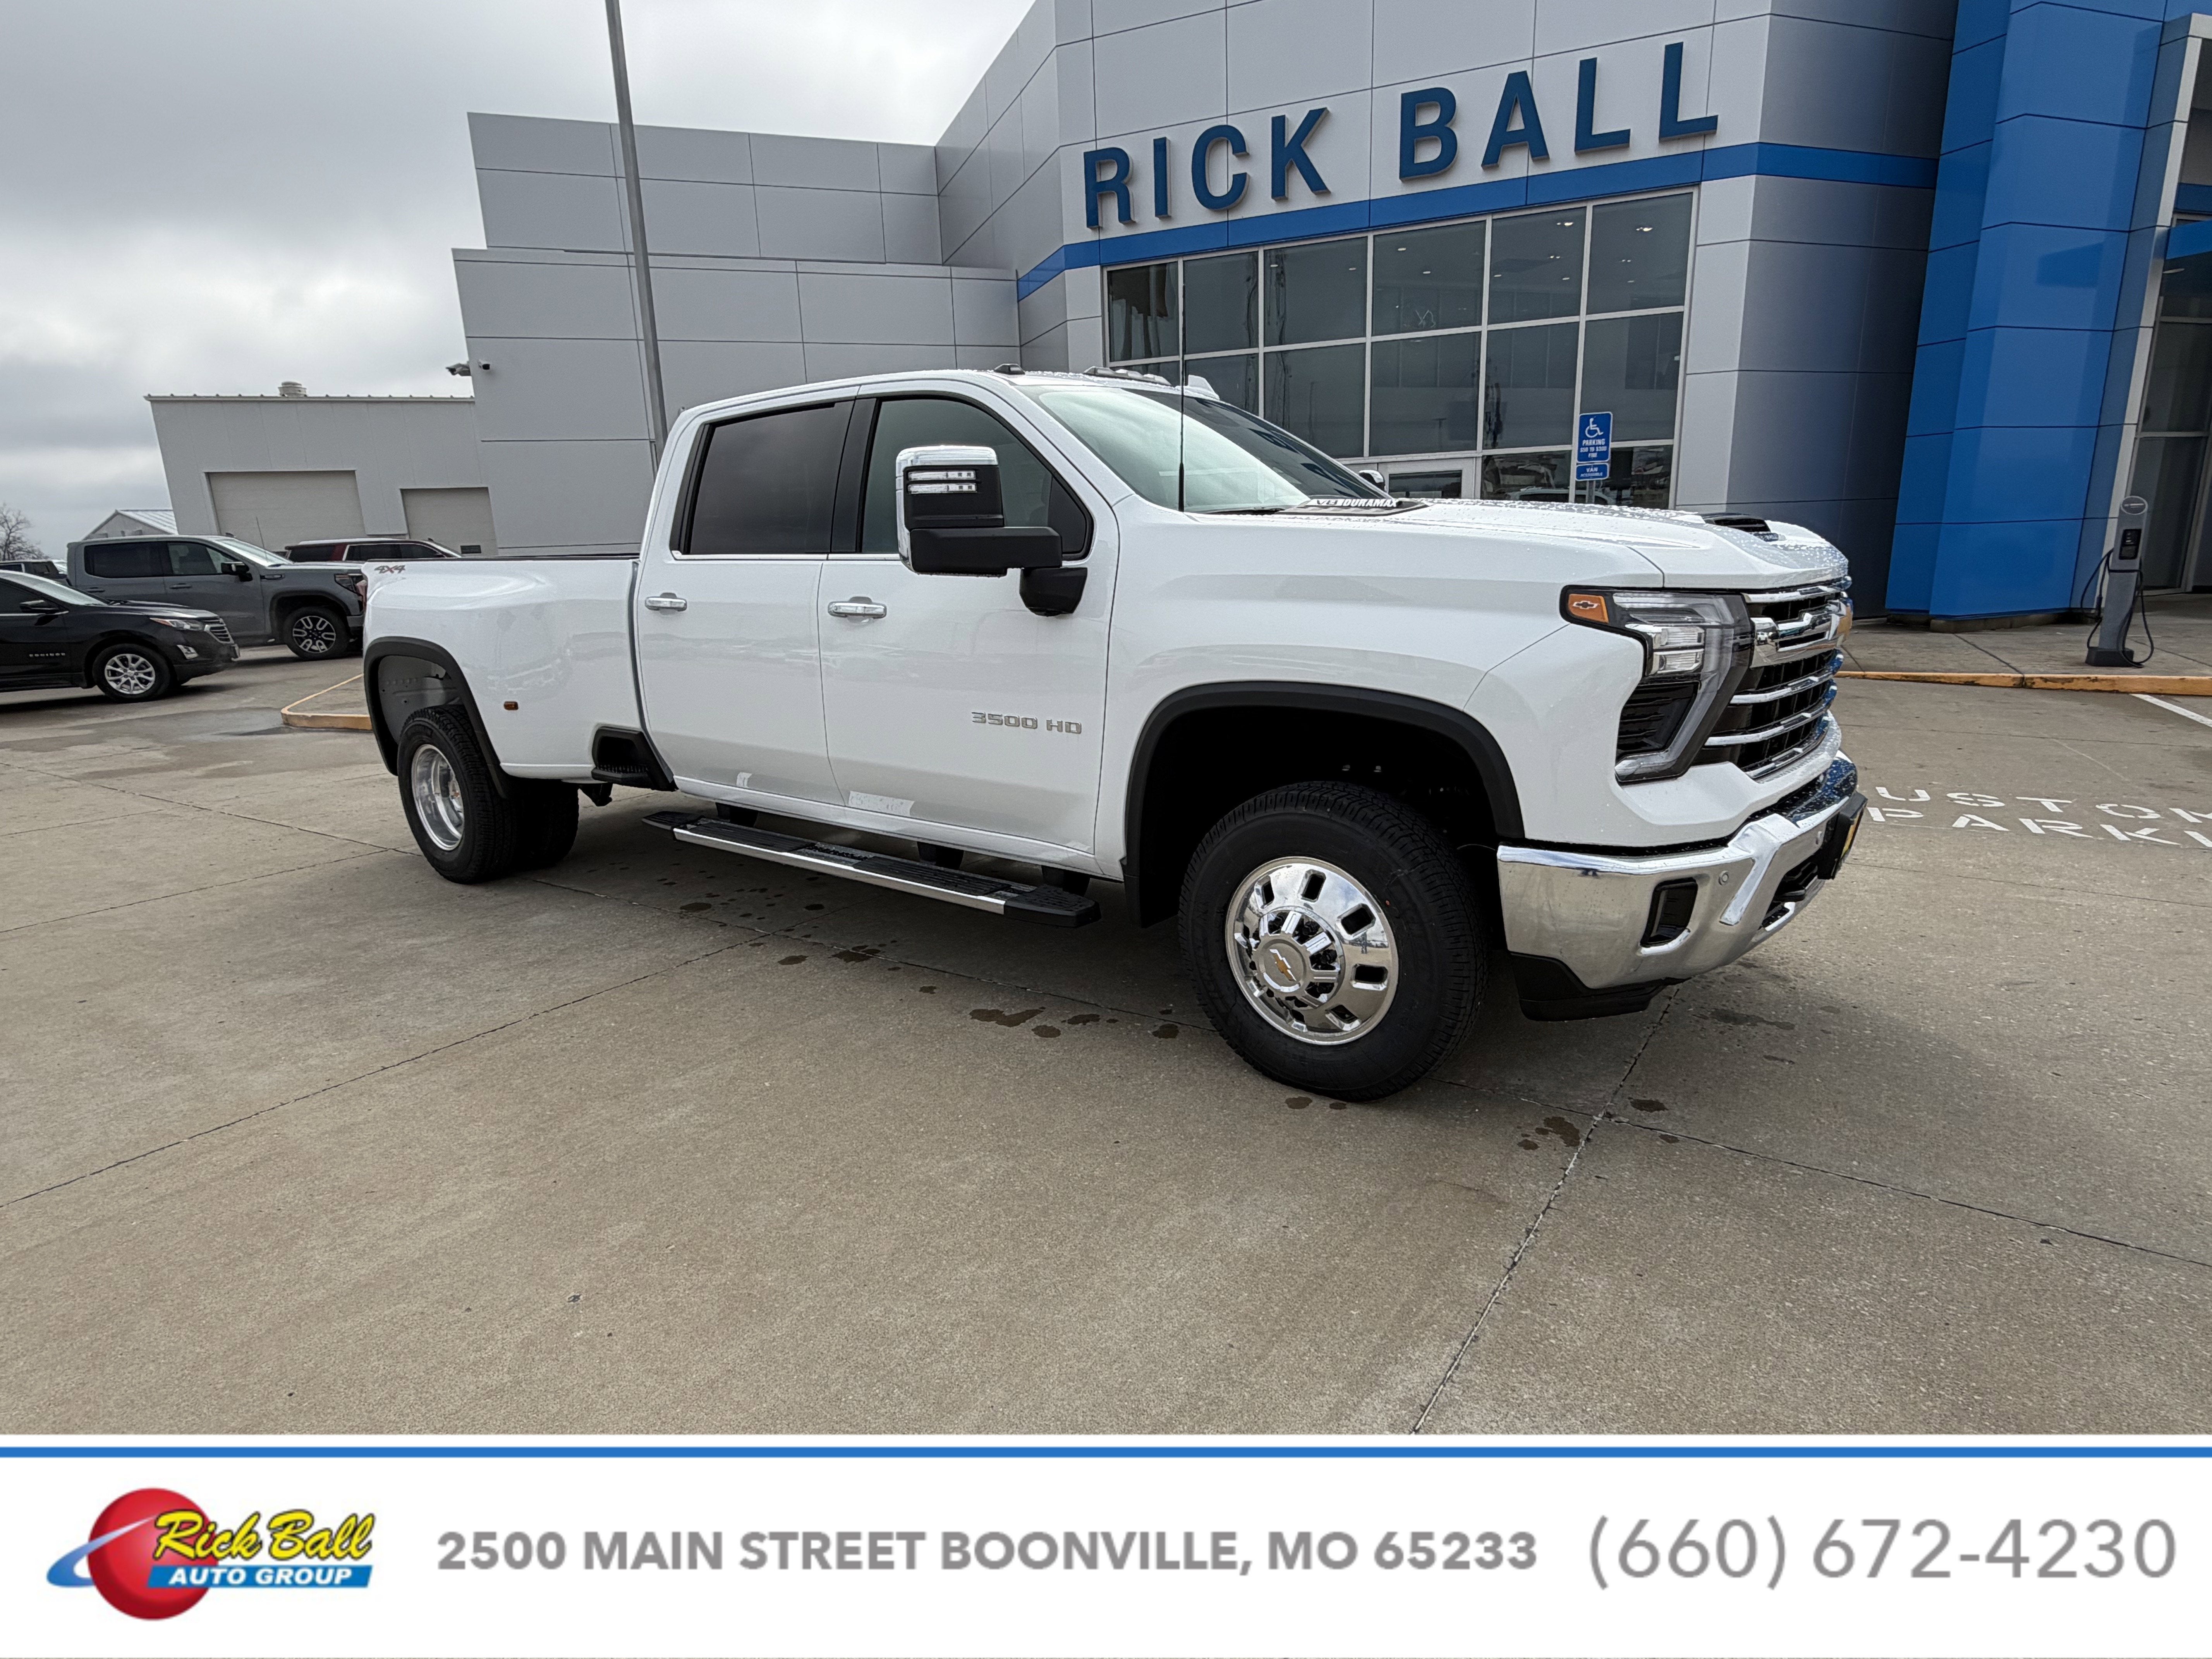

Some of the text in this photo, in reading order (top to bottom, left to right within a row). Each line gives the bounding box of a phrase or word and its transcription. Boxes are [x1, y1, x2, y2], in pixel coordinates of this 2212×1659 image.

[1083, 41, 1719, 229] RICK BALL
[1341, 499, 1396, 507] DURAMAX
[971, 712, 1082, 734] 3500 HD
